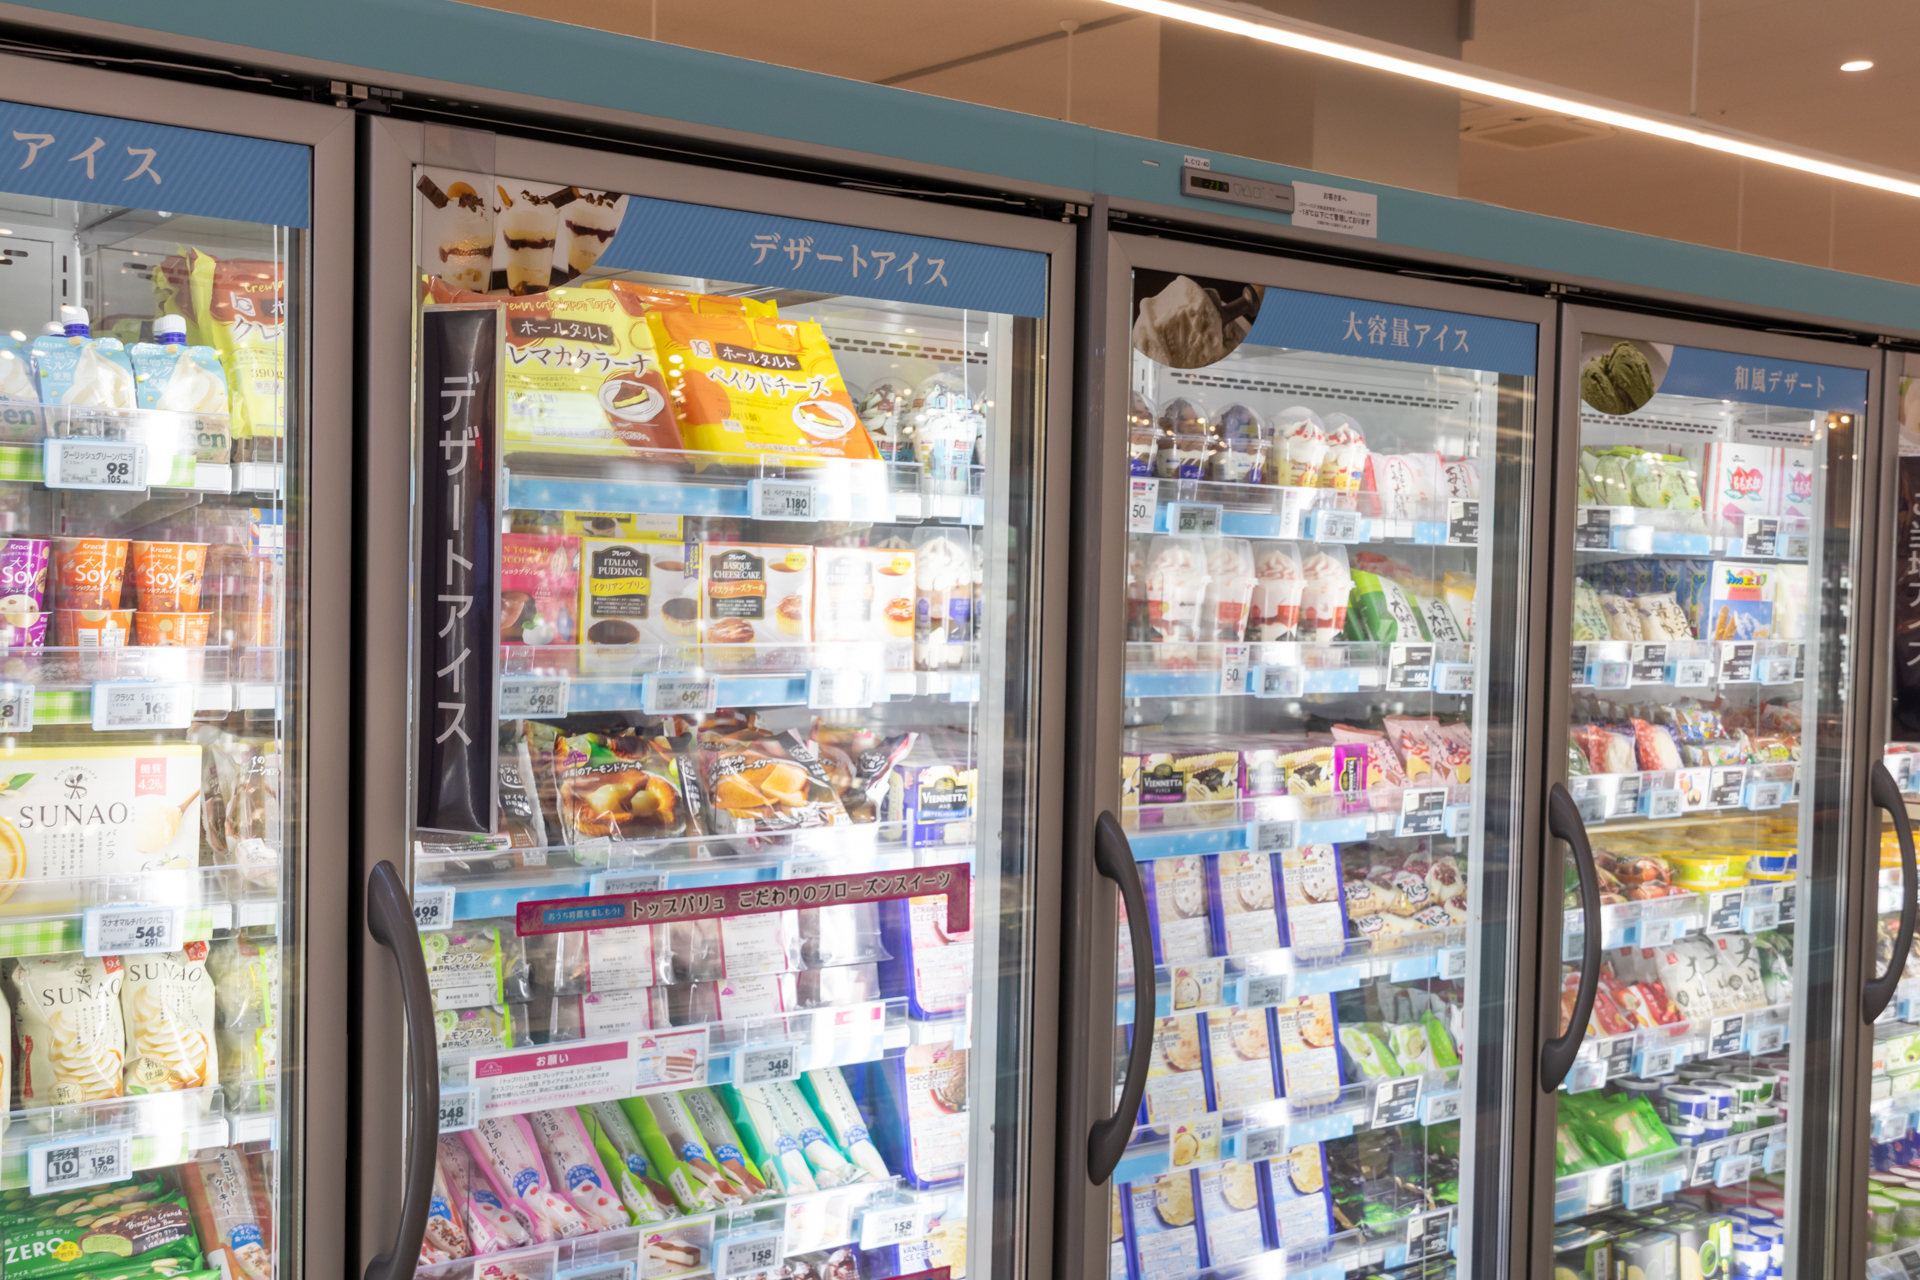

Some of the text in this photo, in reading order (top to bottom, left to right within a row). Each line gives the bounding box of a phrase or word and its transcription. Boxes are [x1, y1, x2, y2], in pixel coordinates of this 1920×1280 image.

[12, 129, 162, 185] アイス
[1323, 192, 1347, 202] お客さまへ
[749, 233, 949, 288] デザートアイス
[520, 320, 608, 341] ホールタルト
[1342, 311, 1470, 354] 大容量アイス
[723, 347, 795, 369] ホールタルト
[43, 358, 77, 371] ミルク
[52, 371, 72, 381] 使用
[1734, 365, 1826, 398] 和風デザート
[709, 368, 831, 397] ベイクドチーズ
[106, 463, 129, 475] 98
[1132, 505, 1146, 518] 50
[1183, 519, 1192, 527] 50
[10, 557, 35, 570] 大人の
[82, 556, 107, 568] 大人の
[152, 559, 177, 571] 大人の
[435, 371, 481, 747] デザートアイス
[604, 558, 638, 566] ITALIAN
[598, 566, 643, 576] PUDDING
[722, 561, 752, 571] BASQUE
[1, 566, 38, 589] Soy
[75, 565, 111, 587] Soy
[146, 568, 180, 589] Soy
[713, 570, 761, 580] CHEESECAKE
[592, 580, 648, 592] イタリアンプリン
[709, 584, 765, 594] バスクチーズケーキ
[1226, 668, 1239, 683] 50
[530, 695, 555, 706] 698
[145, 702, 174, 714] 168
[140, 764, 162, 773] 糖質
[1144, 778, 1183, 787] VIENNETTA
[922, 792, 967, 803] VIENNETTA
[19, 802, 128, 828] SUNAO
[105, 828, 117, 859] バニラ
[631, 891, 725, 920] トップバリュ
[738, 871, 951, 911] こだわりのフローズンスイーツ
[414, 906, 439, 917] 498
[926, 912, 947, 921] CREA
[136, 925, 166, 938] 548
[442, 953, 481, 964] モンブラン
[130, 963, 203, 982] SUNAO
[43, 978, 120, 1006] SUNAO
[451, 1029, 492, 1040] モンブラン
[536, 1054, 569, 1066] お願い
[768, 1059, 789, 1071] 348
[909, 1071, 951, 1082] CHOCOLATE
[922, 1080, 948, 1089] CREAM
[56, 1086, 70, 1098] 新
[439, 1107, 464, 1119] 348
[91, 1154, 114, 1167] 158
[53, 1162, 73, 1175] 10
[220, 1153, 237, 1196] チョコレート
[215, 1179, 231, 1215] ケーキバー
[158, 1210, 182, 1222] Crunch
[894, 1221, 912, 1232] 158
[5, 1237, 65, 1264] ZERO
[902, 1242, 935, 1254] VANILLA
[751, 1250, 772, 1262] 158
[903, 1249, 942, 1262] ICE CREAM
